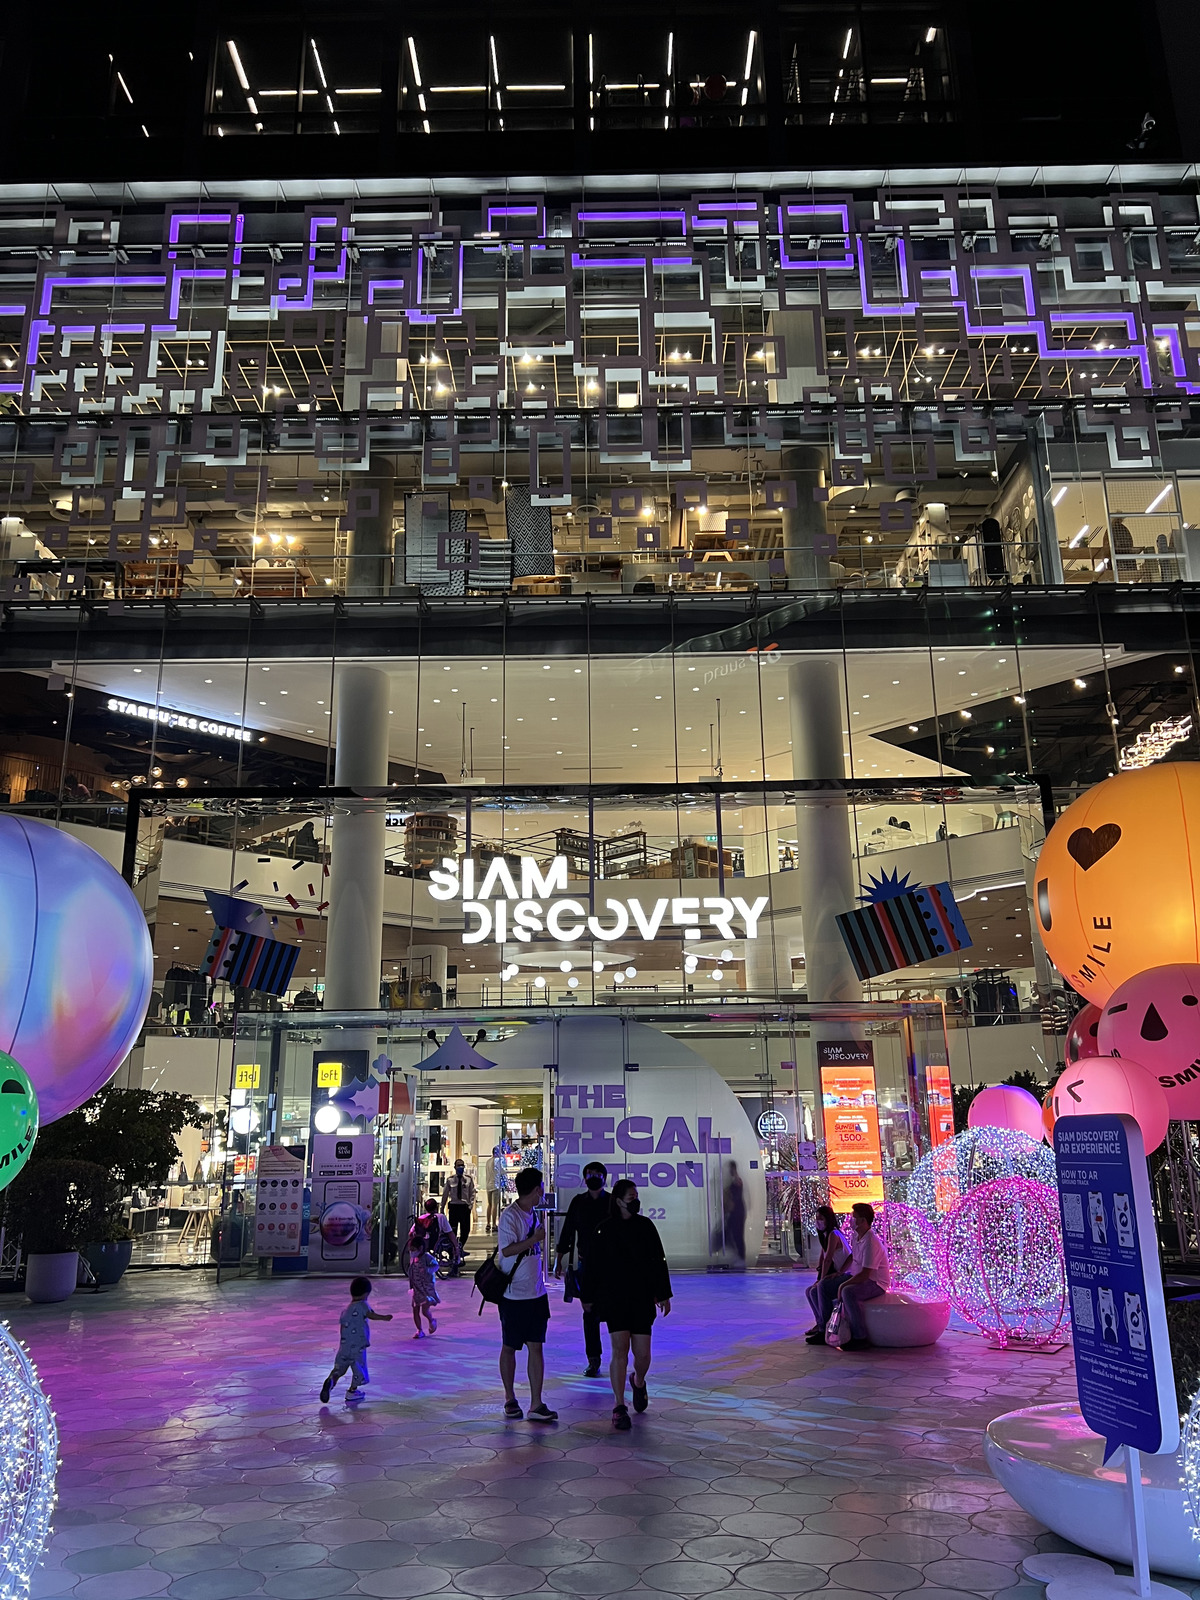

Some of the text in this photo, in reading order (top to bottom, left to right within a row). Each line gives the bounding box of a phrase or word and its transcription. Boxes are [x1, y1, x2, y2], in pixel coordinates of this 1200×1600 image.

[107, 698, 252, 743] STARBUCKS COFFEE
[427, 855, 568, 900] SIAM
[461, 896, 769, 944] DISCOVERY
[1071, 916, 1112, 988] SMILE
[1158, 1058, 1200, 1088] SMI
[555, 1085, 626, 1109] THE
[1057, 1130, 1119, 1142] SIAM DISCOVERY
[1059, 1143, 1121, 1154] AR EXPERIENCE
[555, 1162, 704, 1189] STION
[1060, 1170, 1098, 1180] HOW TO AR
[648, 1208, 666, 1219] 22
[1070, 1261, 1109, 1277] HOW TO AR
